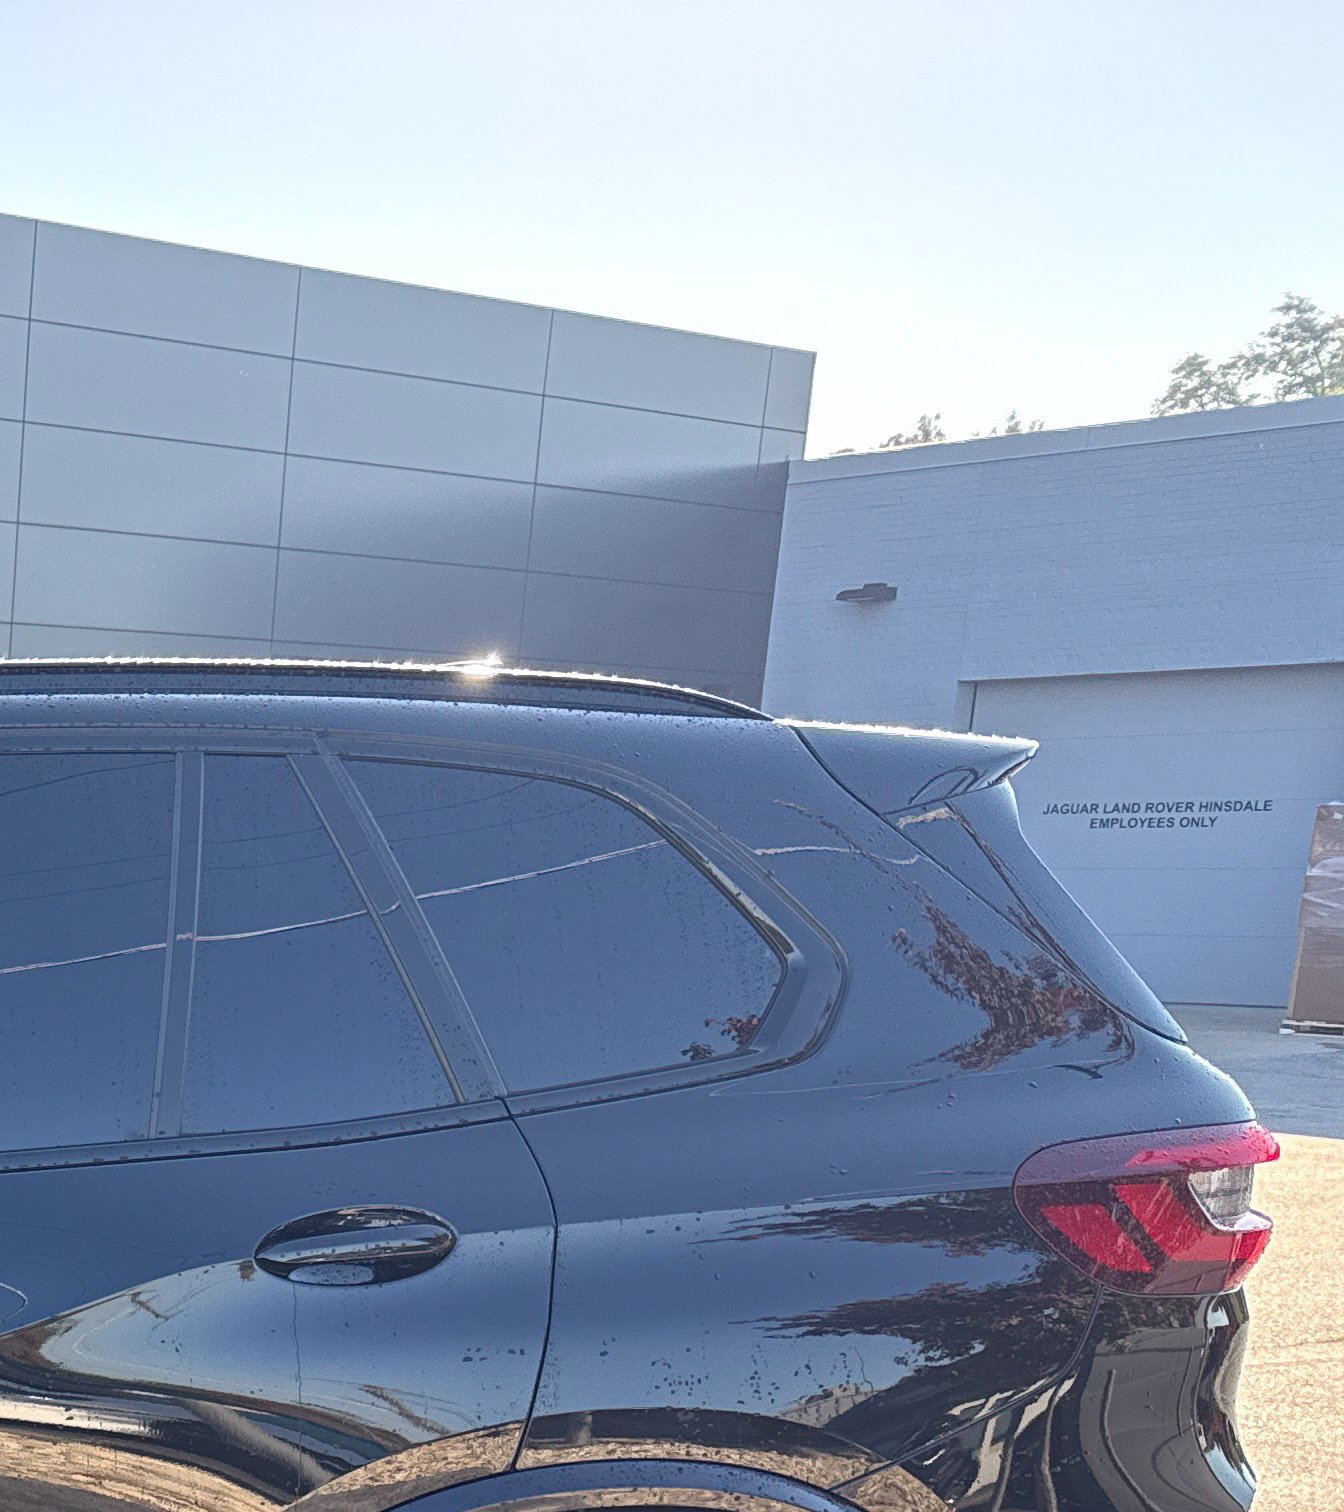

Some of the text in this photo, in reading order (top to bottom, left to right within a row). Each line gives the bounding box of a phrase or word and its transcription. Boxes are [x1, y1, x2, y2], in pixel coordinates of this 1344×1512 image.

[1042, 800, 1274, 815] JAGUAR LAND ROVER HINSDALE
[1089, 816, 1218, 829] EMPLOYEES ONLY
